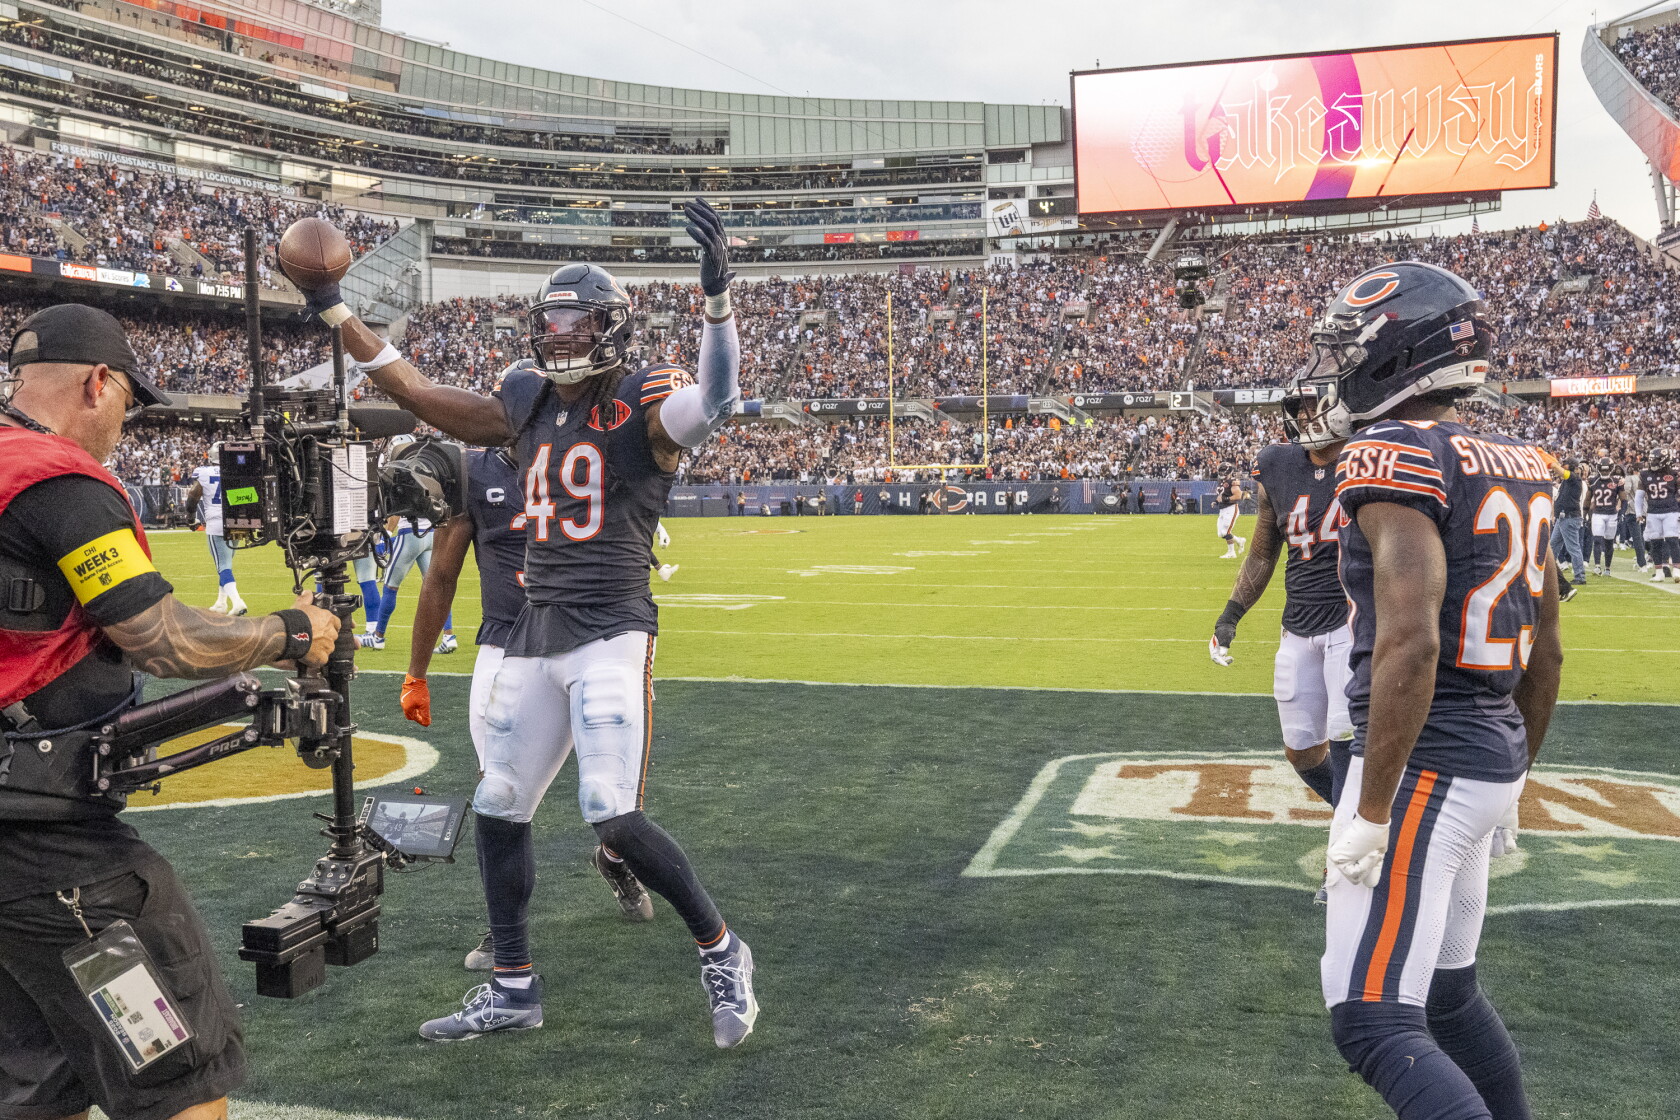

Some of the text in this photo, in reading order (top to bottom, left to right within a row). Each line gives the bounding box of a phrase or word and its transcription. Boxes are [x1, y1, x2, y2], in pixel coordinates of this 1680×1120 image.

[1534, 53, 1545, 96] BEARS
[1182, 69, 1541, 184] takeaway
[51, 142, 69, 153] FOR
[69, 145, 157, 171] SECURITY/ASSISTANCE
[157, 162, 176, 174] TEXT
[177, 167, 198, 178] ISSUE
[205, 172, 242, 186] LOCATION
[242, 178, 252, 187] TO
[200, 283, 241, 299] Mon 7:15 PM
[1567, 376, 1633, 395] takeaway
[821, 402, 838, 410] razr
[1086, 396, 1104, 404] razr
[1135, 395, 1153, 403] razr
[1345, 447, 1400, 480] GSH
[486, 487, 505, 503] C
[524, 442, 605, 541] 49
[1594, 489, 1613, 506] 22
[1648, 482, 1668, 499] 95
[83, 546, 97, 557] CHI
[73, 547, 119, 577] WEEK 3
[95, 565, 107, 575] Field
[107, 558, 124, 568] Access
[1456, 486, 1553, 670] 29
[209, 738, 241, 756] PRO
[110, 1013, 128, 1037] SEASON
